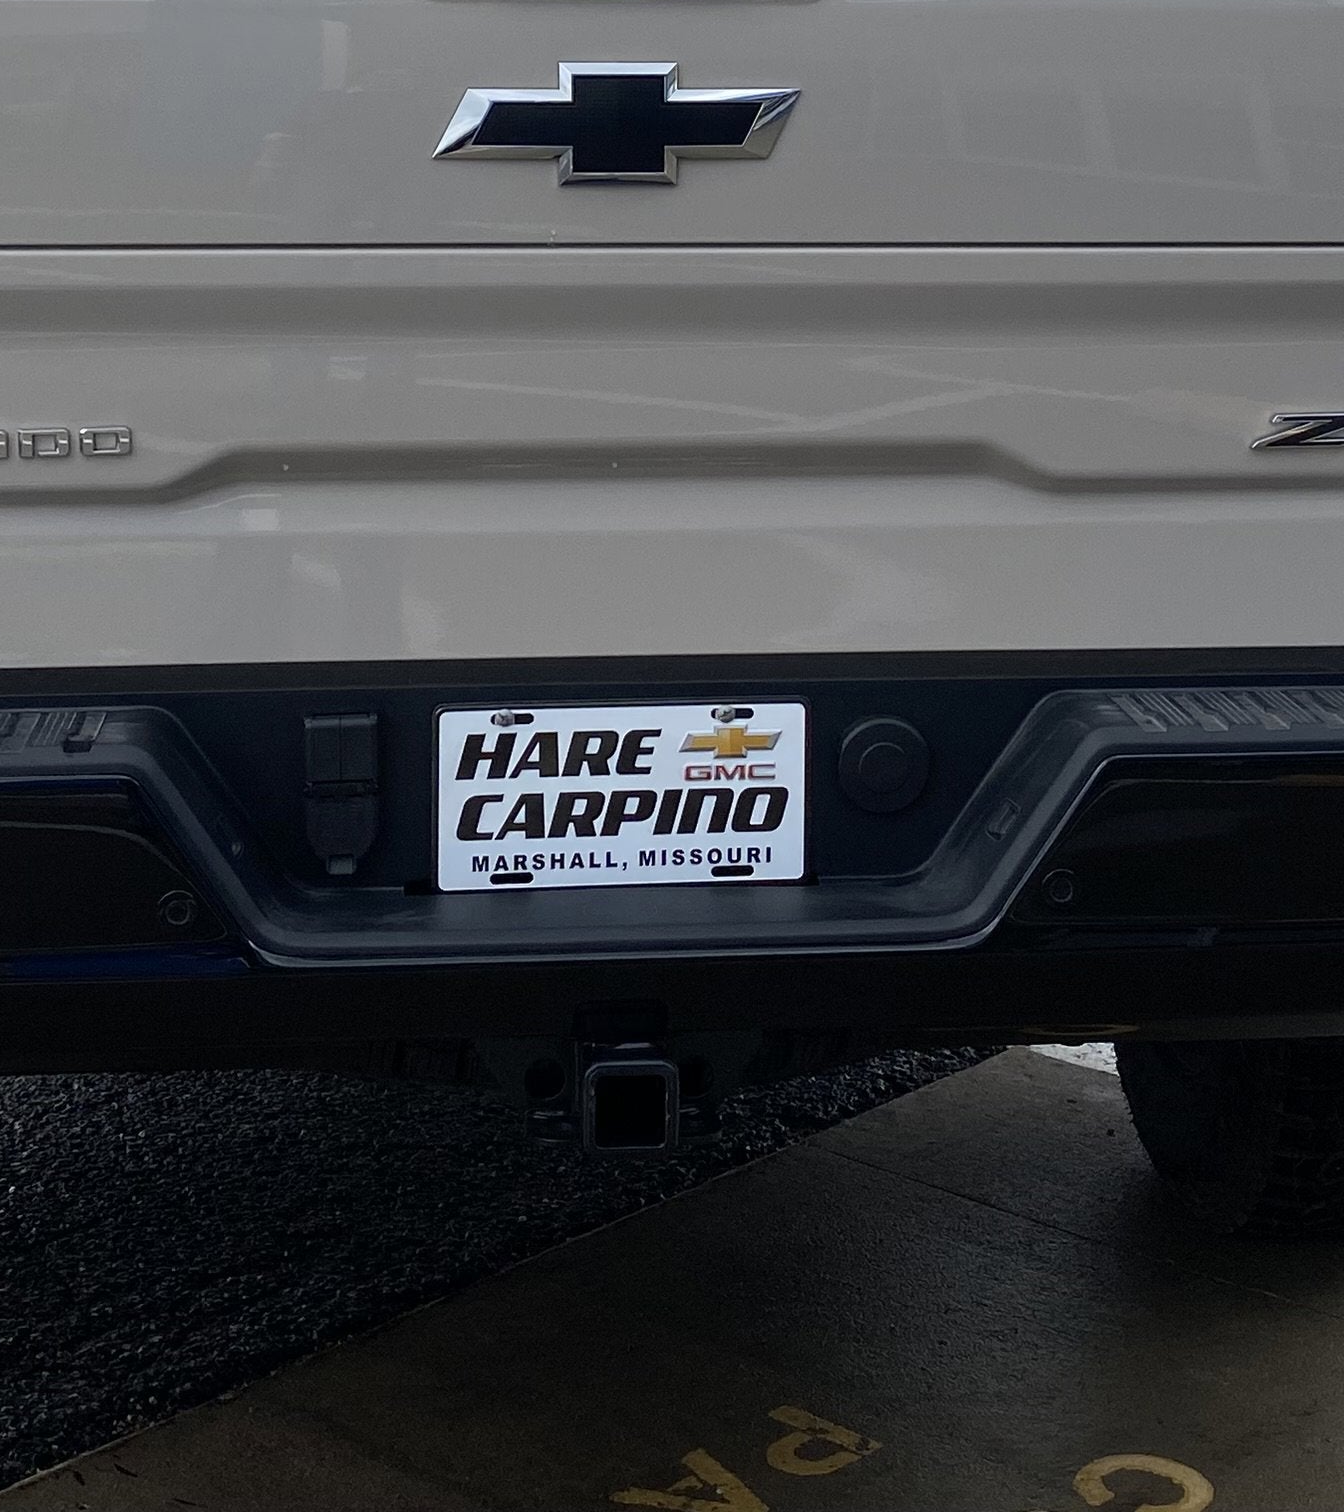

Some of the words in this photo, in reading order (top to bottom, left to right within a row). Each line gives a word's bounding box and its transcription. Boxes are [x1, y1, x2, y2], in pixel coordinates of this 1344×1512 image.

[455, 728, 663, 781] HARE
[683, 761, 778, 782] GMC
[455, 786, 790, 842] CARPINO
[471, 851, 629, 873] MARSHALL,
[638, 846, 772, 868] MISSOURI
